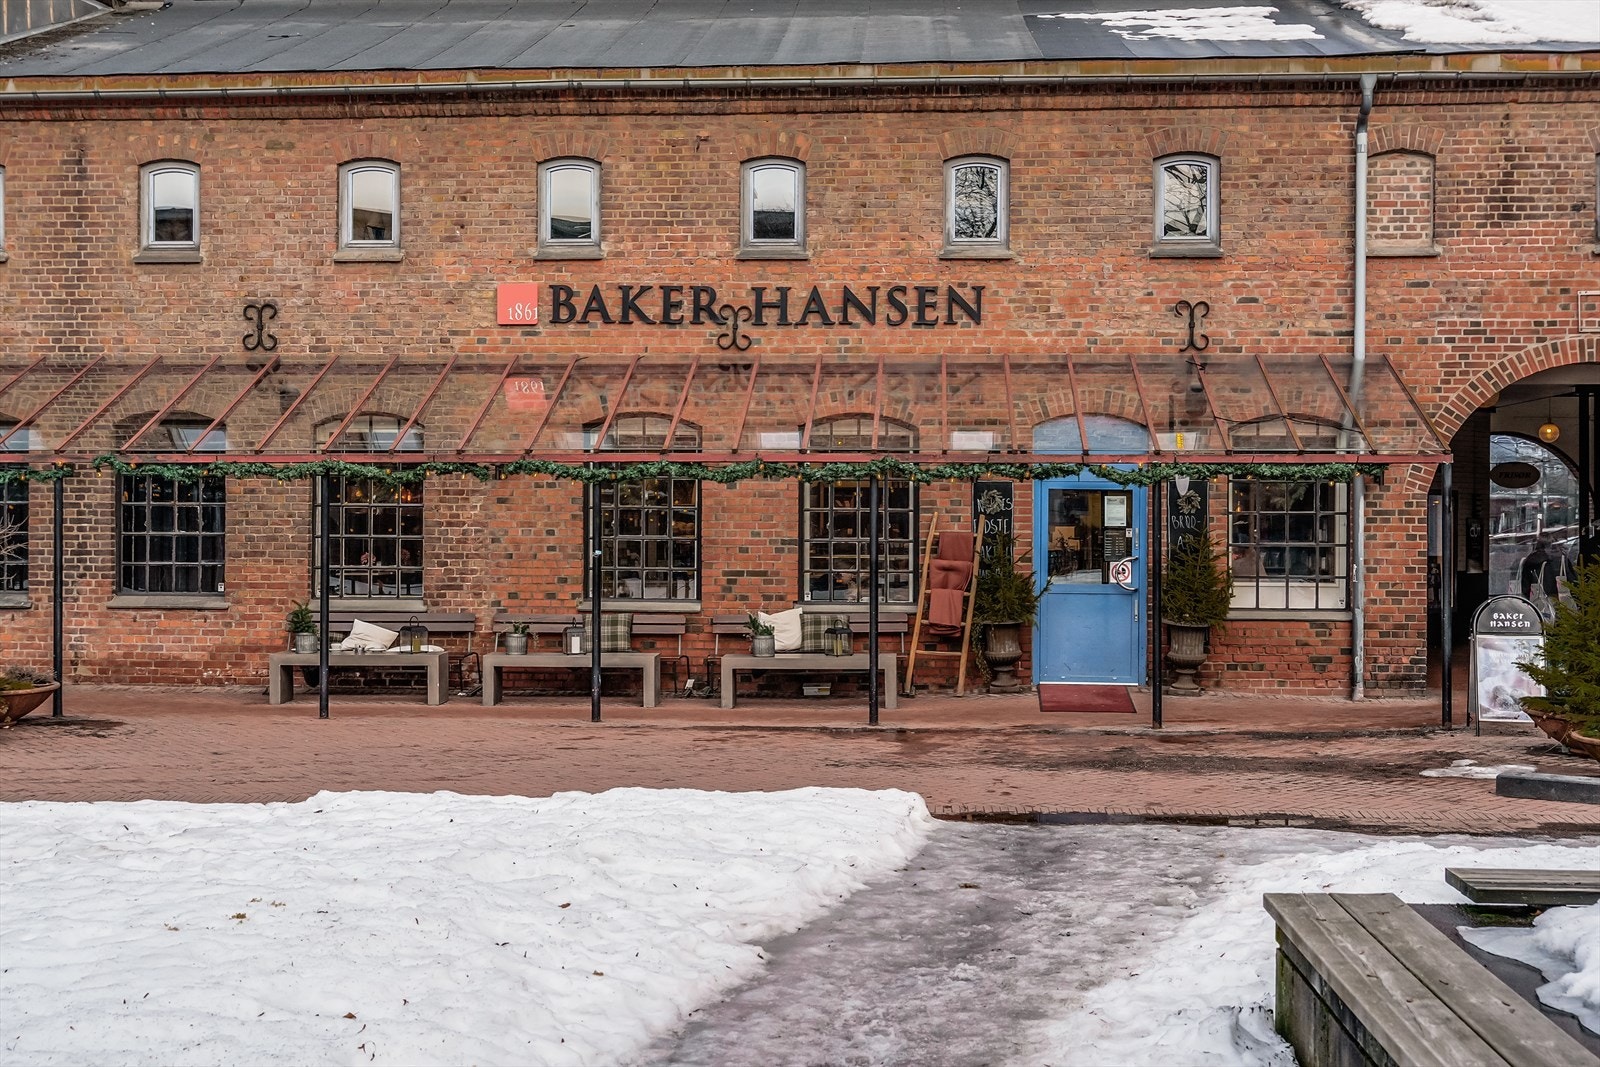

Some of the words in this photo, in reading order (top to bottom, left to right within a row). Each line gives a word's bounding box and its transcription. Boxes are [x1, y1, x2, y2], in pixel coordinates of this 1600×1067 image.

[508, 303, 538, 320] 1861
[549, 284, 724, 325] BAKER
[751, 285, 985, 325] HANSEN
